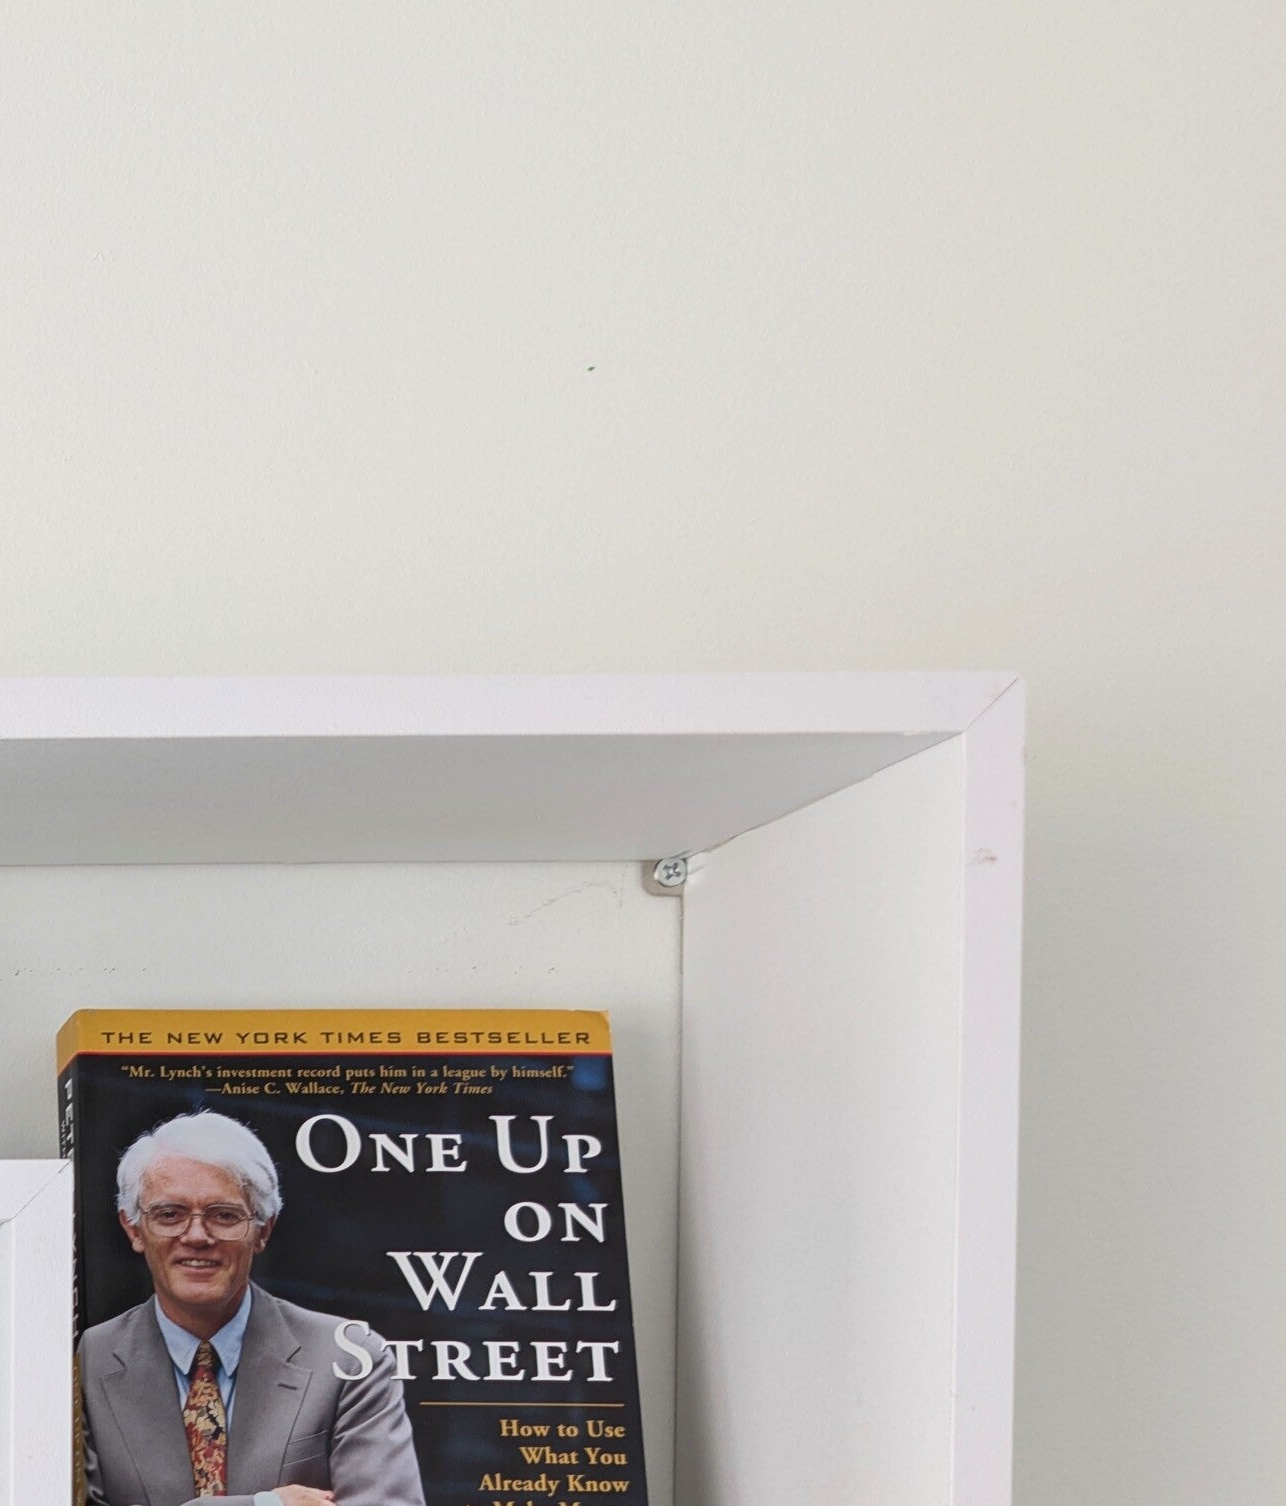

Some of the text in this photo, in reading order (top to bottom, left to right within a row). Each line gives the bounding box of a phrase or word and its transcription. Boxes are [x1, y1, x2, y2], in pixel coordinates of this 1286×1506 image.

[101, 1031, 590, 1044] THE NEW YORK TIMES BESTSELLER
[217, 1065, 292, 1078] investment
[297, 1065, 341, 1078] record
[345, 1067, 375, 1081] puts
[379, 1065, 407, 1078] him
[412, 1065, 426, 1078] in
[430, 1069, 439, 1078] a
[443, 1065, 486, 1081] league
[490, 1065, 508, 1081] by
[264, 1082, 281, 1094] C.
[285, 1082, 344, 1096] Wallace,
[351, 1082, 376, 1094] The
[379, 1082, 411, 1094] New
[416, 1082, 448, 1094] York
[453, 1082, 493, 1094] Times
[295, 1114, 602, 1174] ONE UP
[504, 1201, 609, 1243] ON
[385, 1251, 617, 1311] WALL
[331, 1320, 619, 1381] STREET
[500, 1419, 626, 1437] How to Use
[519, 1446, 628, 1465] What You
[479, 1473, 630, 1497] Already Know
